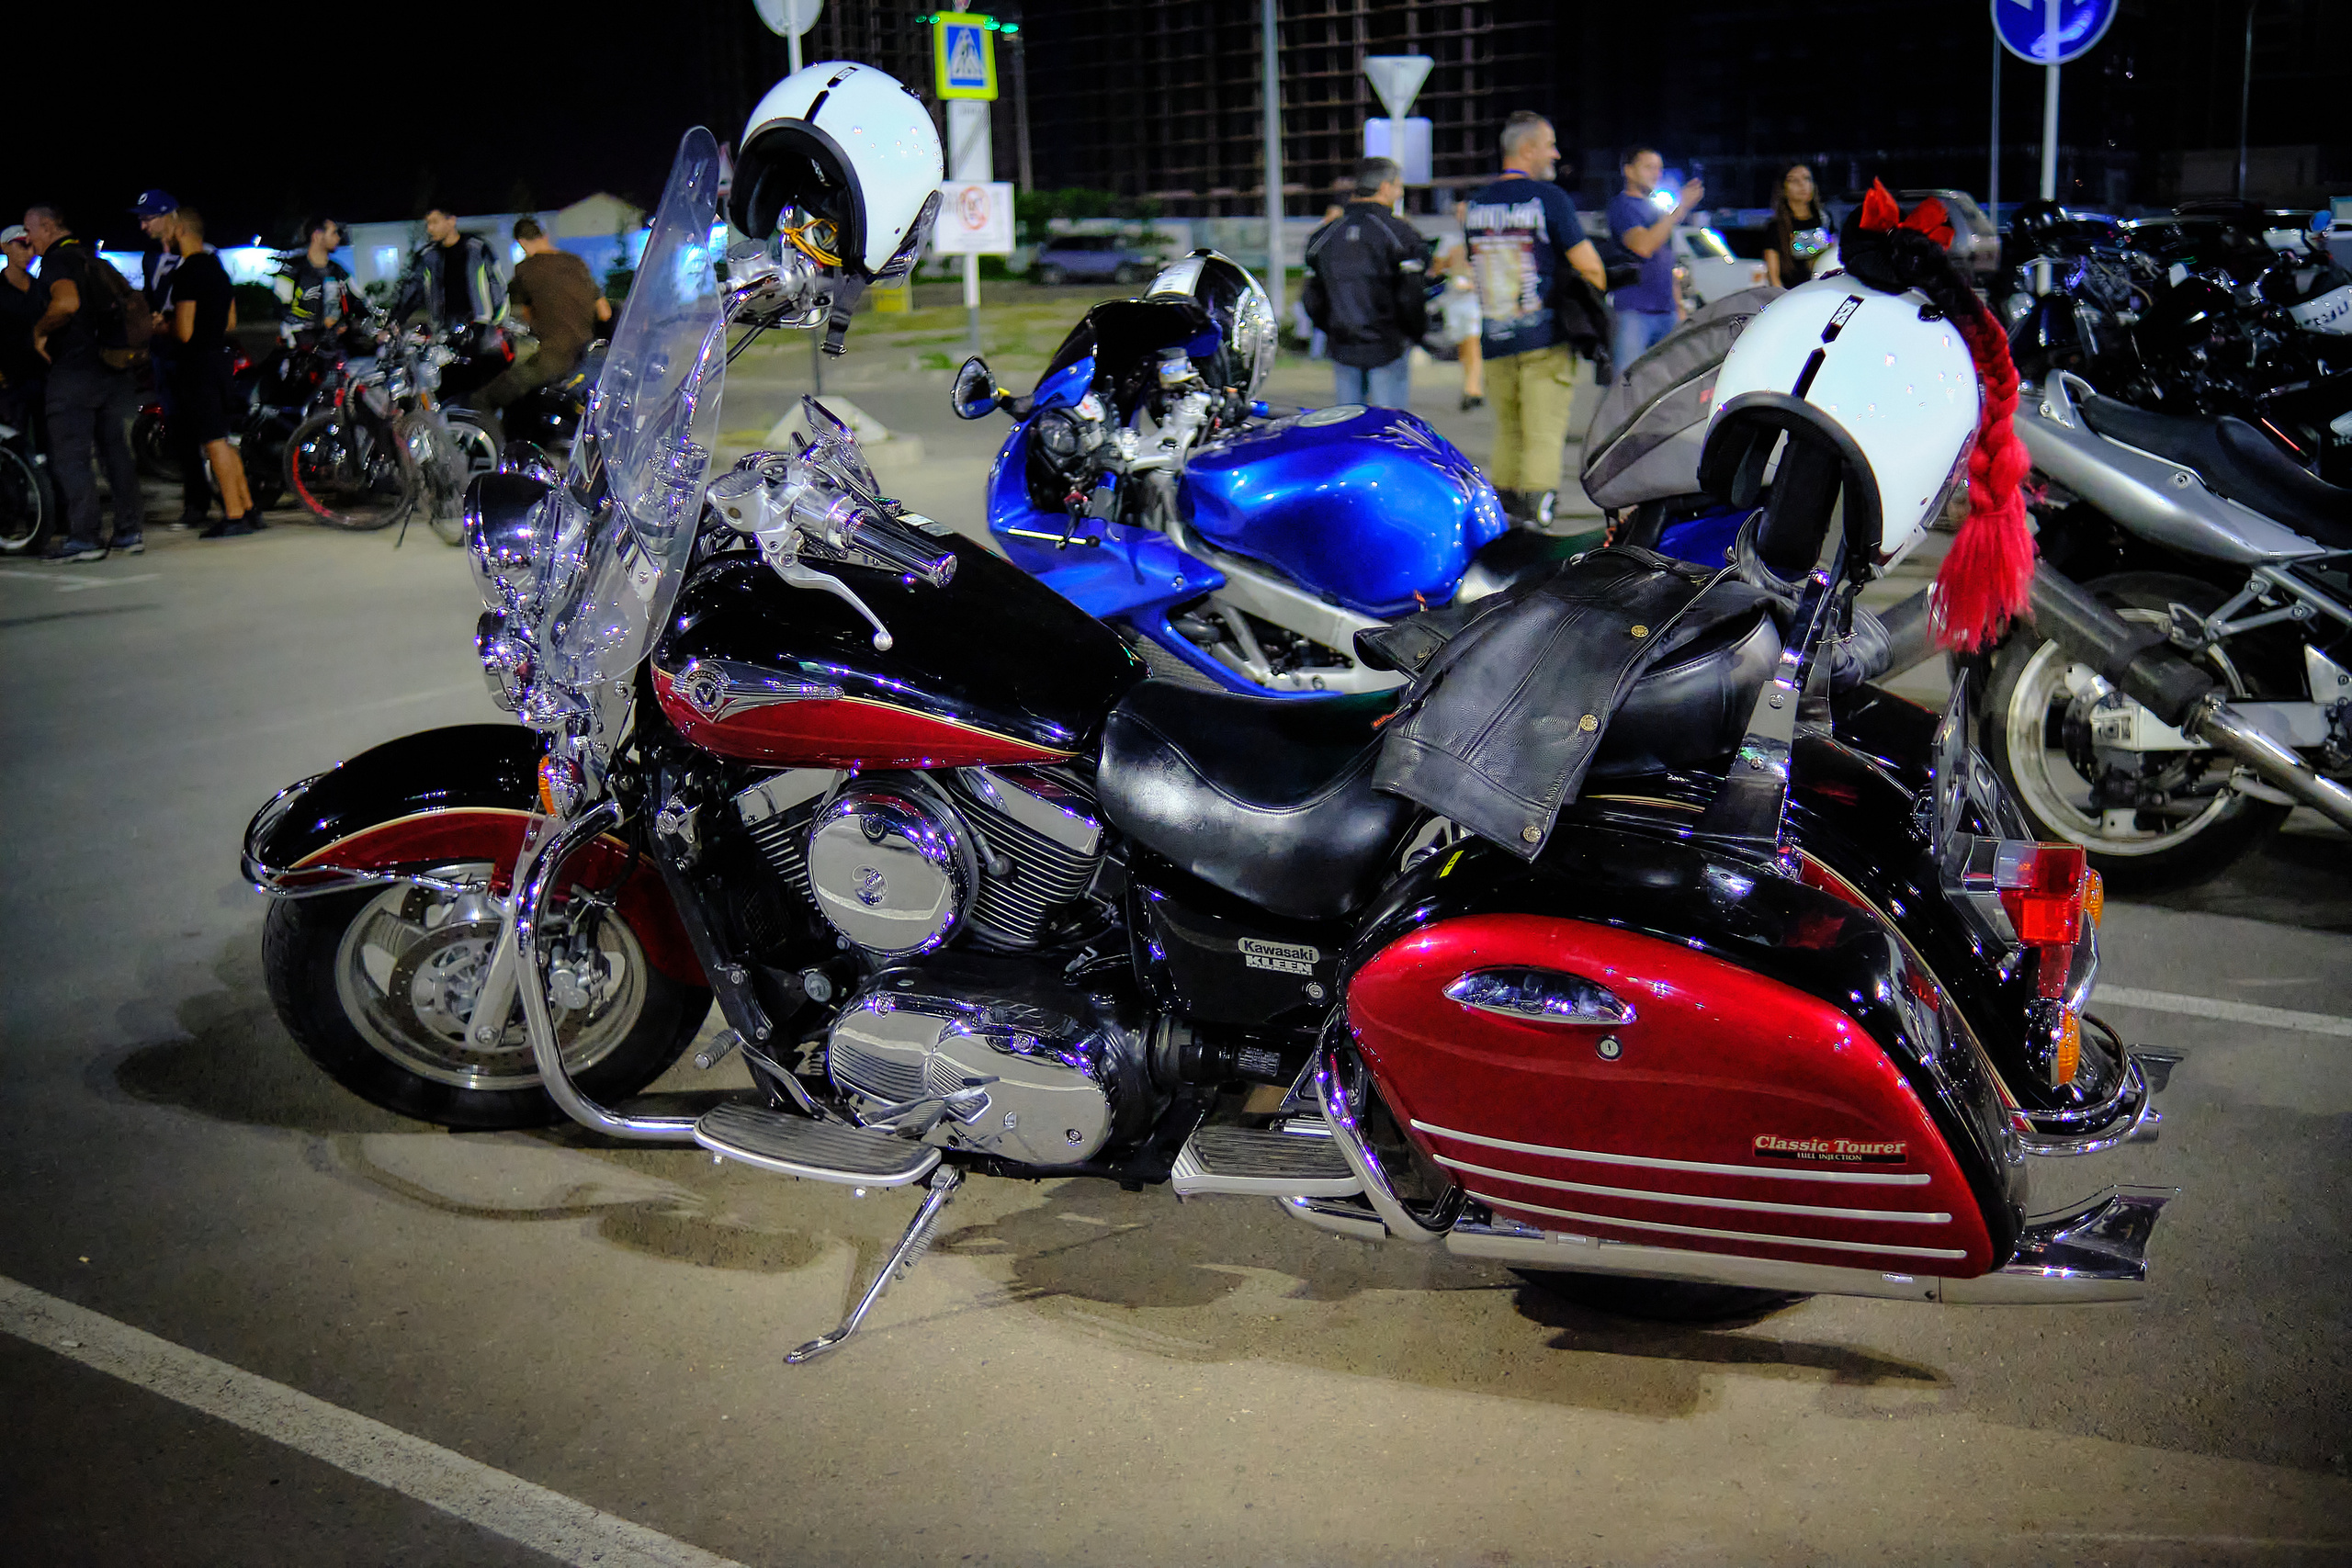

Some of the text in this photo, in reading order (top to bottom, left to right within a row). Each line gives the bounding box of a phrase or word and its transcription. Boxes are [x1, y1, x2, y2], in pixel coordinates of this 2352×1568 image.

[1244, 940, 1314, 961] Kawasaki
[1246, 955, 1312, 974] KLEEN
[1755, 1135, 1906, 1154] Classic Tourer
